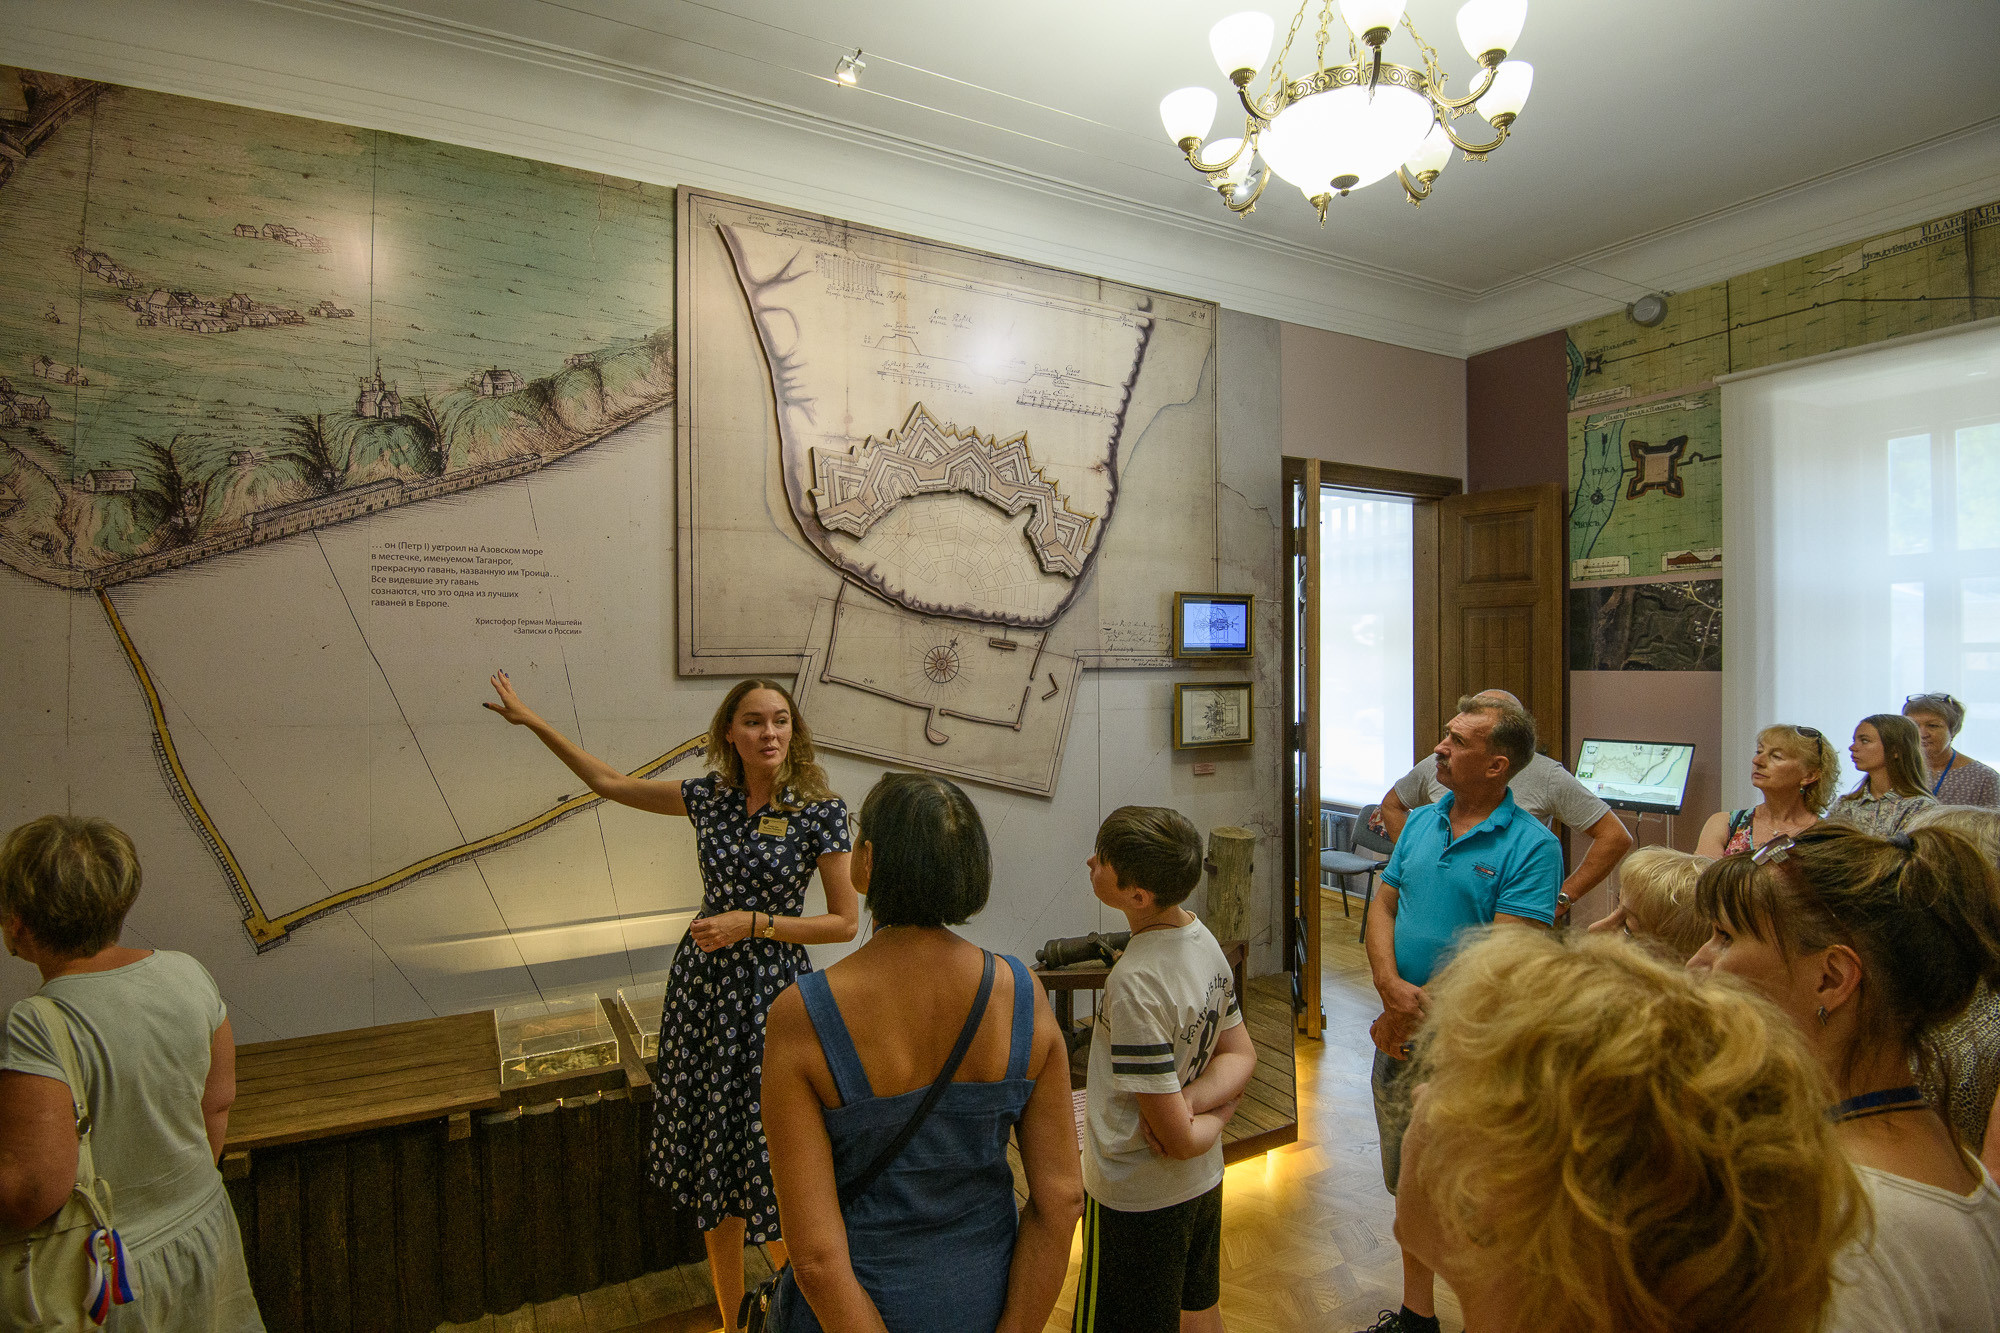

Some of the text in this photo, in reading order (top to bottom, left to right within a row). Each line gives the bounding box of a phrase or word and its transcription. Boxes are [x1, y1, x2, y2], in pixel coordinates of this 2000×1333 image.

[398, 541, 423, 551] (Петр
[480, 545, 520, 555] Азовском
[522, 548, 544, 556] море
[378, 553, 422, 563] местечке,
[423, 555, 474, 564] именуемом
[476, 556, 514, 566] Таганрог,
[371, 565, 425, 575] прекрасную
[427, 566, 459, 575] гавань,
[460, 568, 506, 577] названную
[371, 574, 387, 584] Все
[388, 577, 434, 585] видевшие
[435, 578, 449, 587] эту
[371, 588, 420, 597] сознаются,
[453, 590, 475, 598] одна
[487, 590, 519, 598] лучших
[371, 598, 407, 608] гаваней
[416, 599, 450, 609] Европе.
[475, 617, 582, 626] Христофор Герман Манштейн
[513, 627, 547, 635] «Записки
[554, 627, 582, 635] России»
[1214, 973, 1229, 991] the
